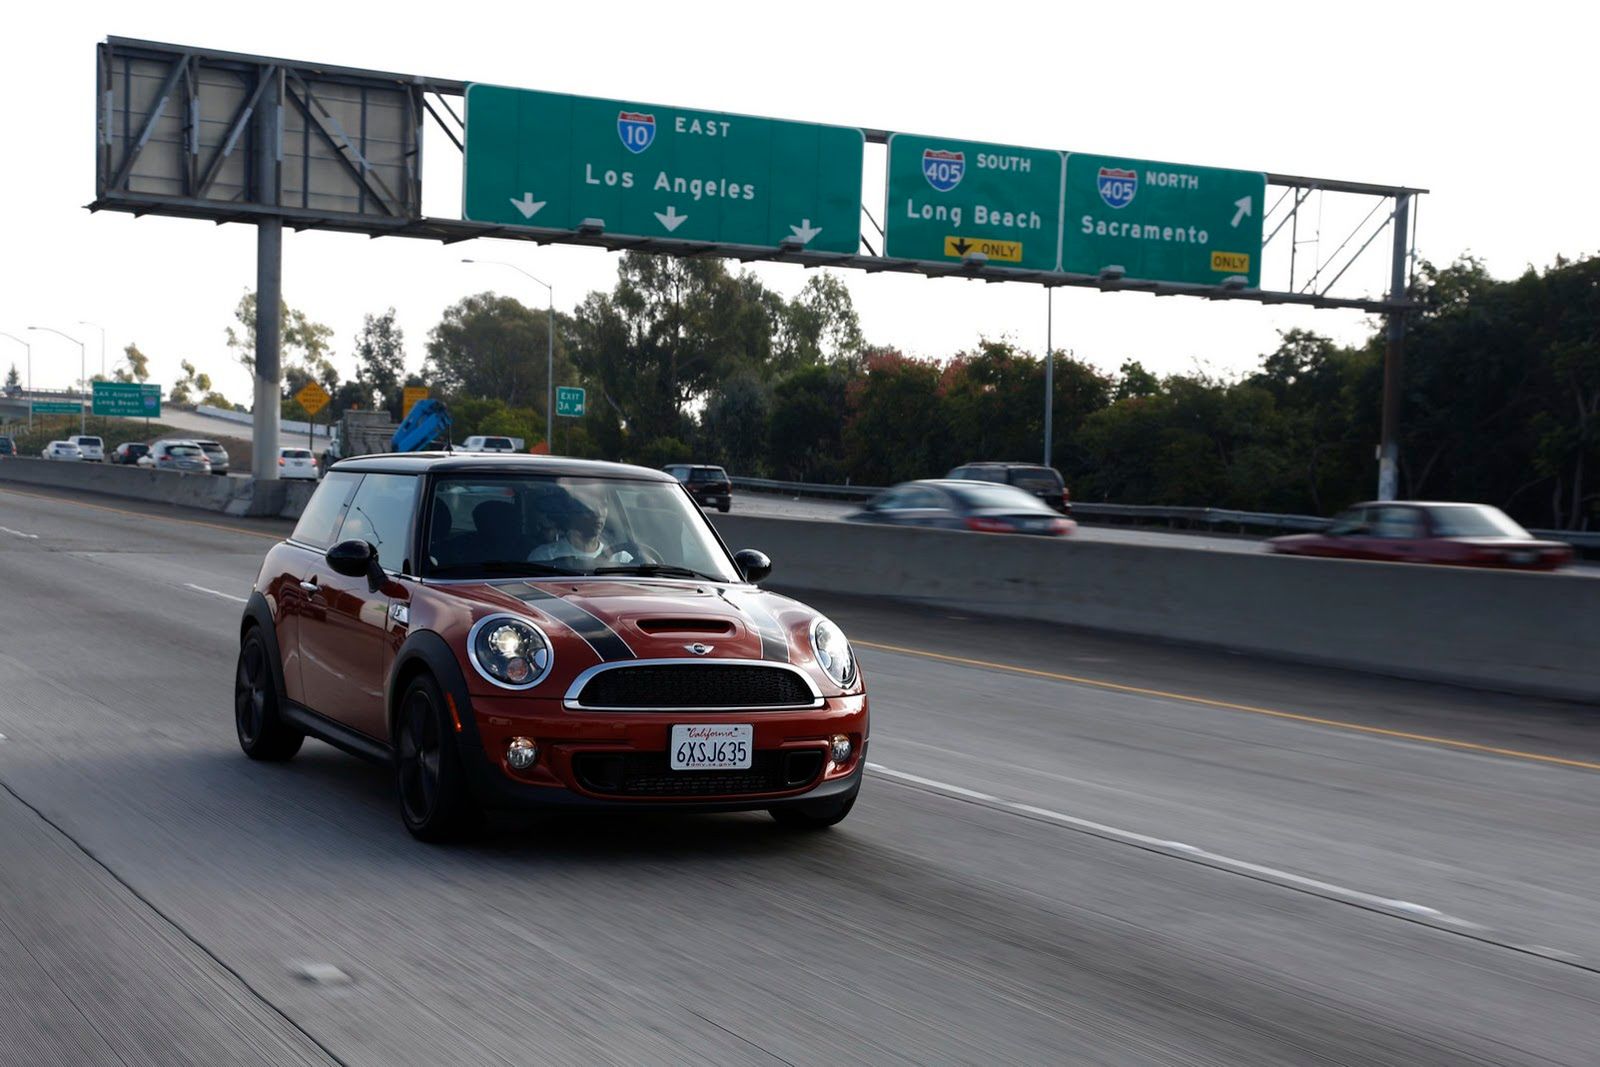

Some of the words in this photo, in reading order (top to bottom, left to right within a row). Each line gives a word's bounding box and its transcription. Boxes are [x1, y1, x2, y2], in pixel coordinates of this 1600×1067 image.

[627, 124, 648, 146] 10
[674, 115, 732, 138] EAST
[585, 163, 635, 188] Los
[654, 171, 756, 202] Angeles
[926, 162, 961, 184] 405
[976, 153, 1032, 173] SOUTH
[1100, 181, 1133, 202] 405
[1145, 170, 1200, 190] NORTH
[906, 198, 963, 228] Long
[974, 205, 1042, 231] Beach
[1080, 214, 1210, 245] Sacramento
[981, 243, 1016, 258] ONLY
[1214, 255, 1246, 269] ONLY
[560, 392, 580, 401] EXIT
[688, 727, 738, 740] California
[676, 741, 747, 763] 6XSJ635
